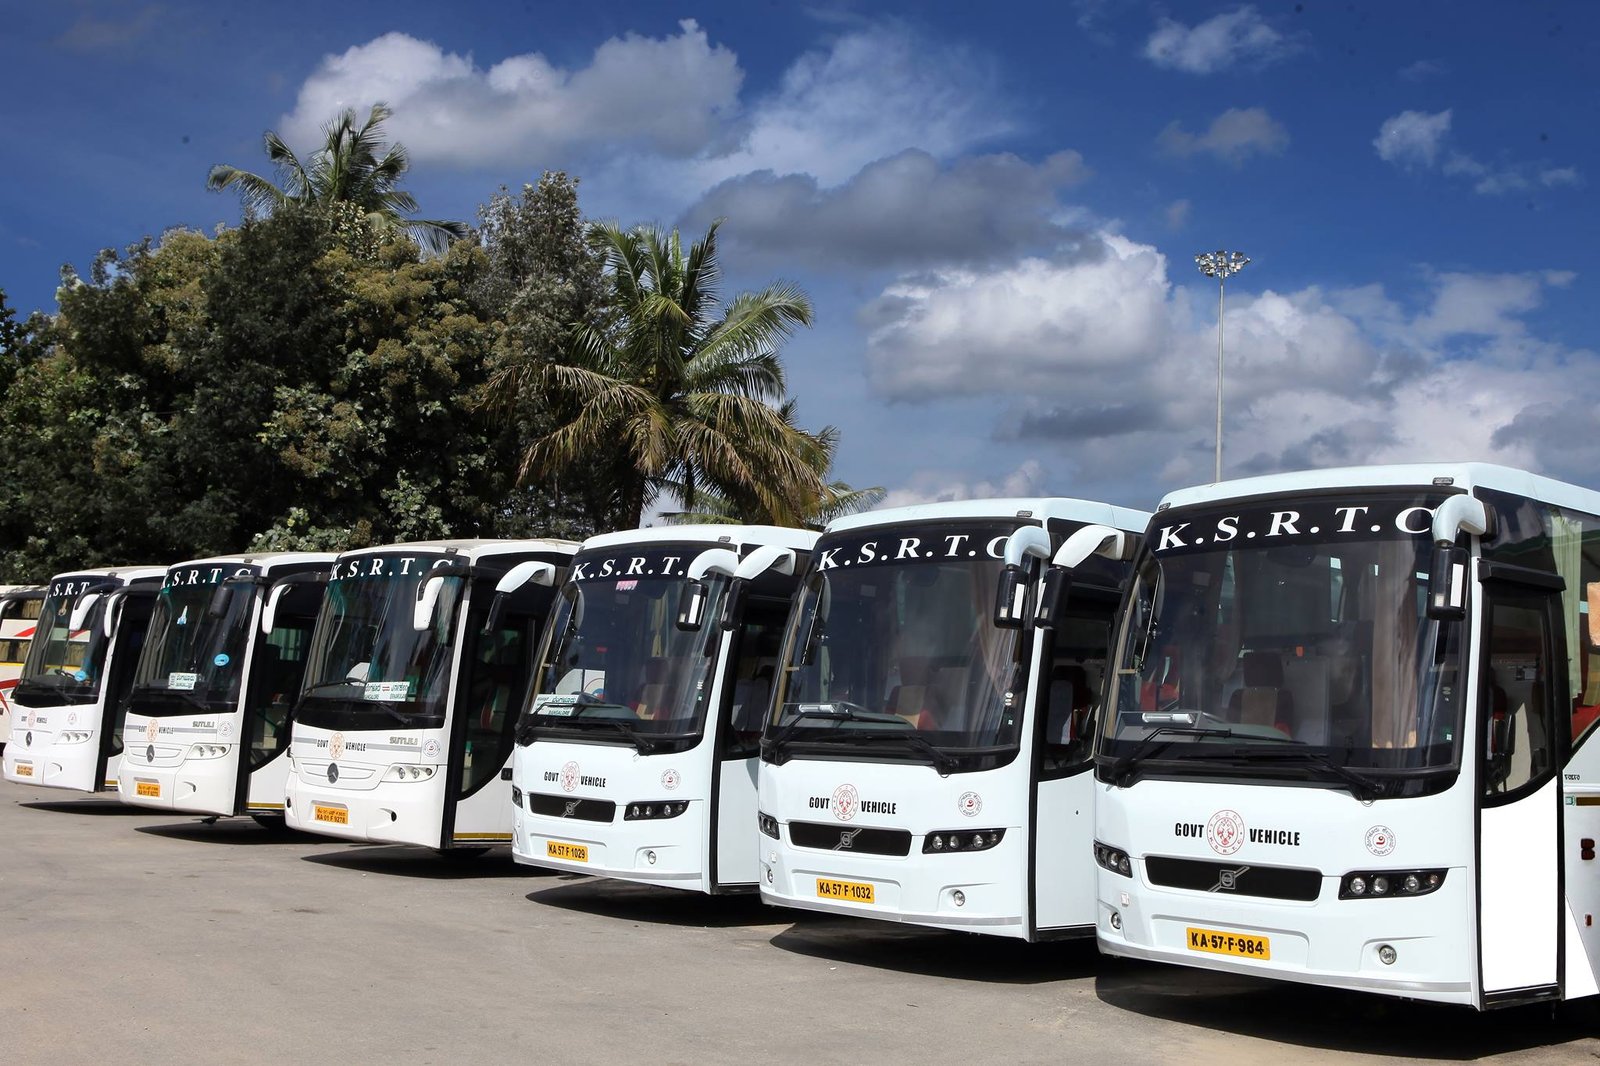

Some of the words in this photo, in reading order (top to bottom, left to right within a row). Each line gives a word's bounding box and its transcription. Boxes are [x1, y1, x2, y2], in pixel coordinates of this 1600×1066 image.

[317, 739, 329, 748] GOVT
[345, 741, 366, 751] VEHICLE
[543, 771, 559, 782] GOVT
[580, 775, 606, 787] VEHICLE
[809, 796, 830, 809] GOVT
[861, 800, 897, 814] VEHICLE
[1175, 822, 1204, 838] GOVT
[1250, 828, 1301, 846] VEHICLE
[548, 844, 557, 855] KA
[558, 845, 565, 856] 57
[571, 847, 586, 859] 1029
[819, 882, 831, 894] KA
[832, 883, 842, 896] 57
[844, 885, 849, 896] F
[851, 885, 871, 899] 1032
